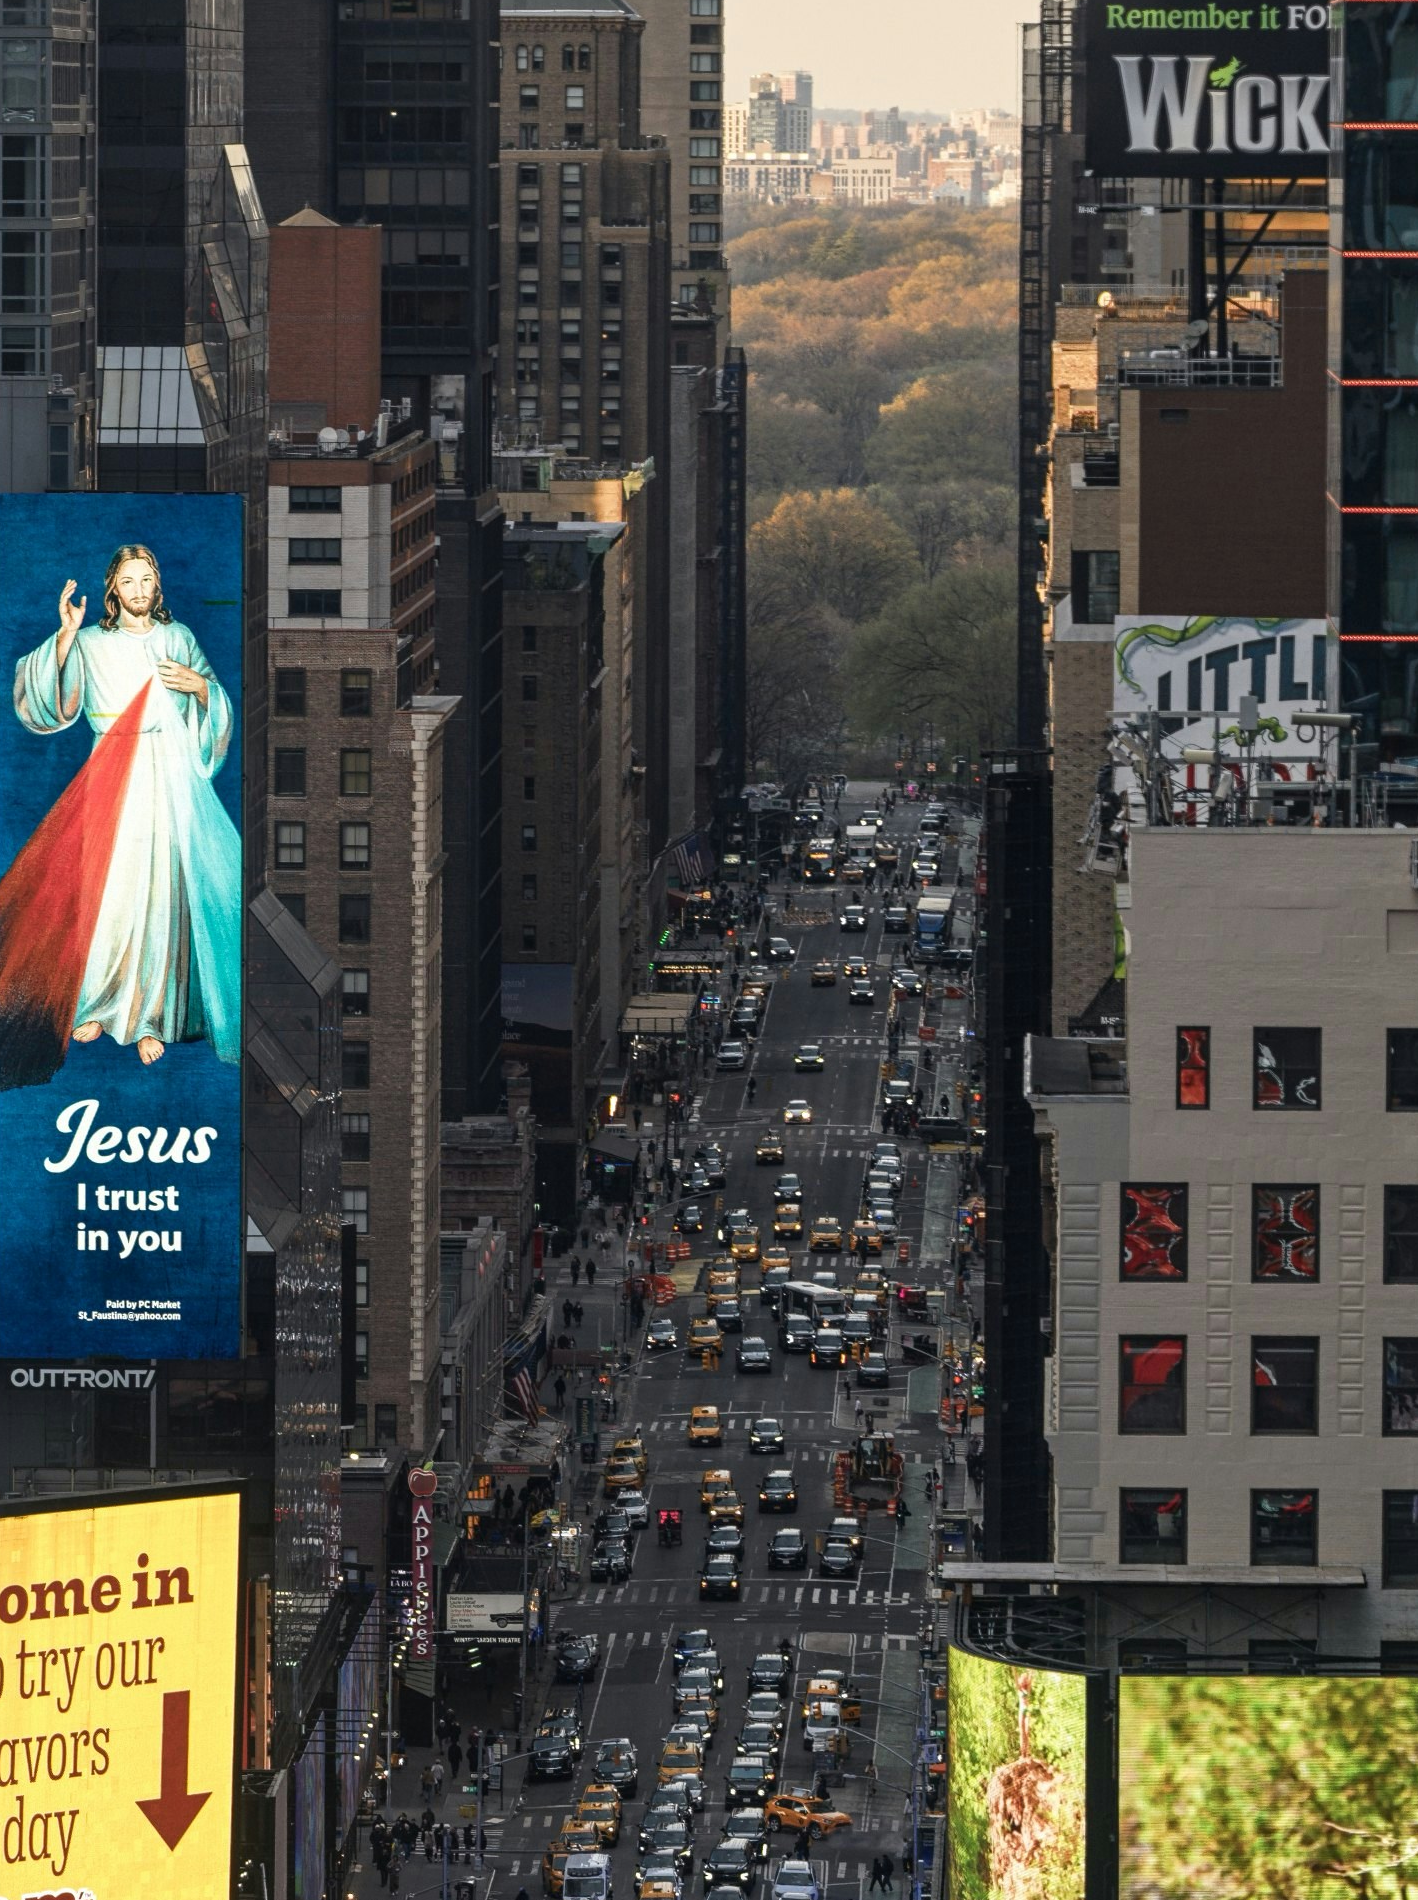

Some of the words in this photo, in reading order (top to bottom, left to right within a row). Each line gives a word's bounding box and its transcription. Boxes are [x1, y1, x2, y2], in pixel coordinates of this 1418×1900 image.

[1106, 5, 1252, 30] Remember
[1260, 4, 1280, 30] it
[1113, 54, 1331, 154] WICK
[43, 1099, 218, 1174] Jesus
[77, 1183, 86, 1211] I
[95, 1184, 179, 1212] trust
[77, 1222, 108, 1251] in
[118, 1229, 182, 1259] you
[78, 1310, 181, 1322] St_Faustina@yahoo.com
[106, 1299, 125, 1310] Paid
[126, 1299, 138, 1311] by
[138, 1299, 151, 1310] PC
[152, 1299, 181, 1310] Market
[131, 1552, 195, 1609] in
[16, 1639, 85, 1714] try
[95, 1636, 166, 1687] our
